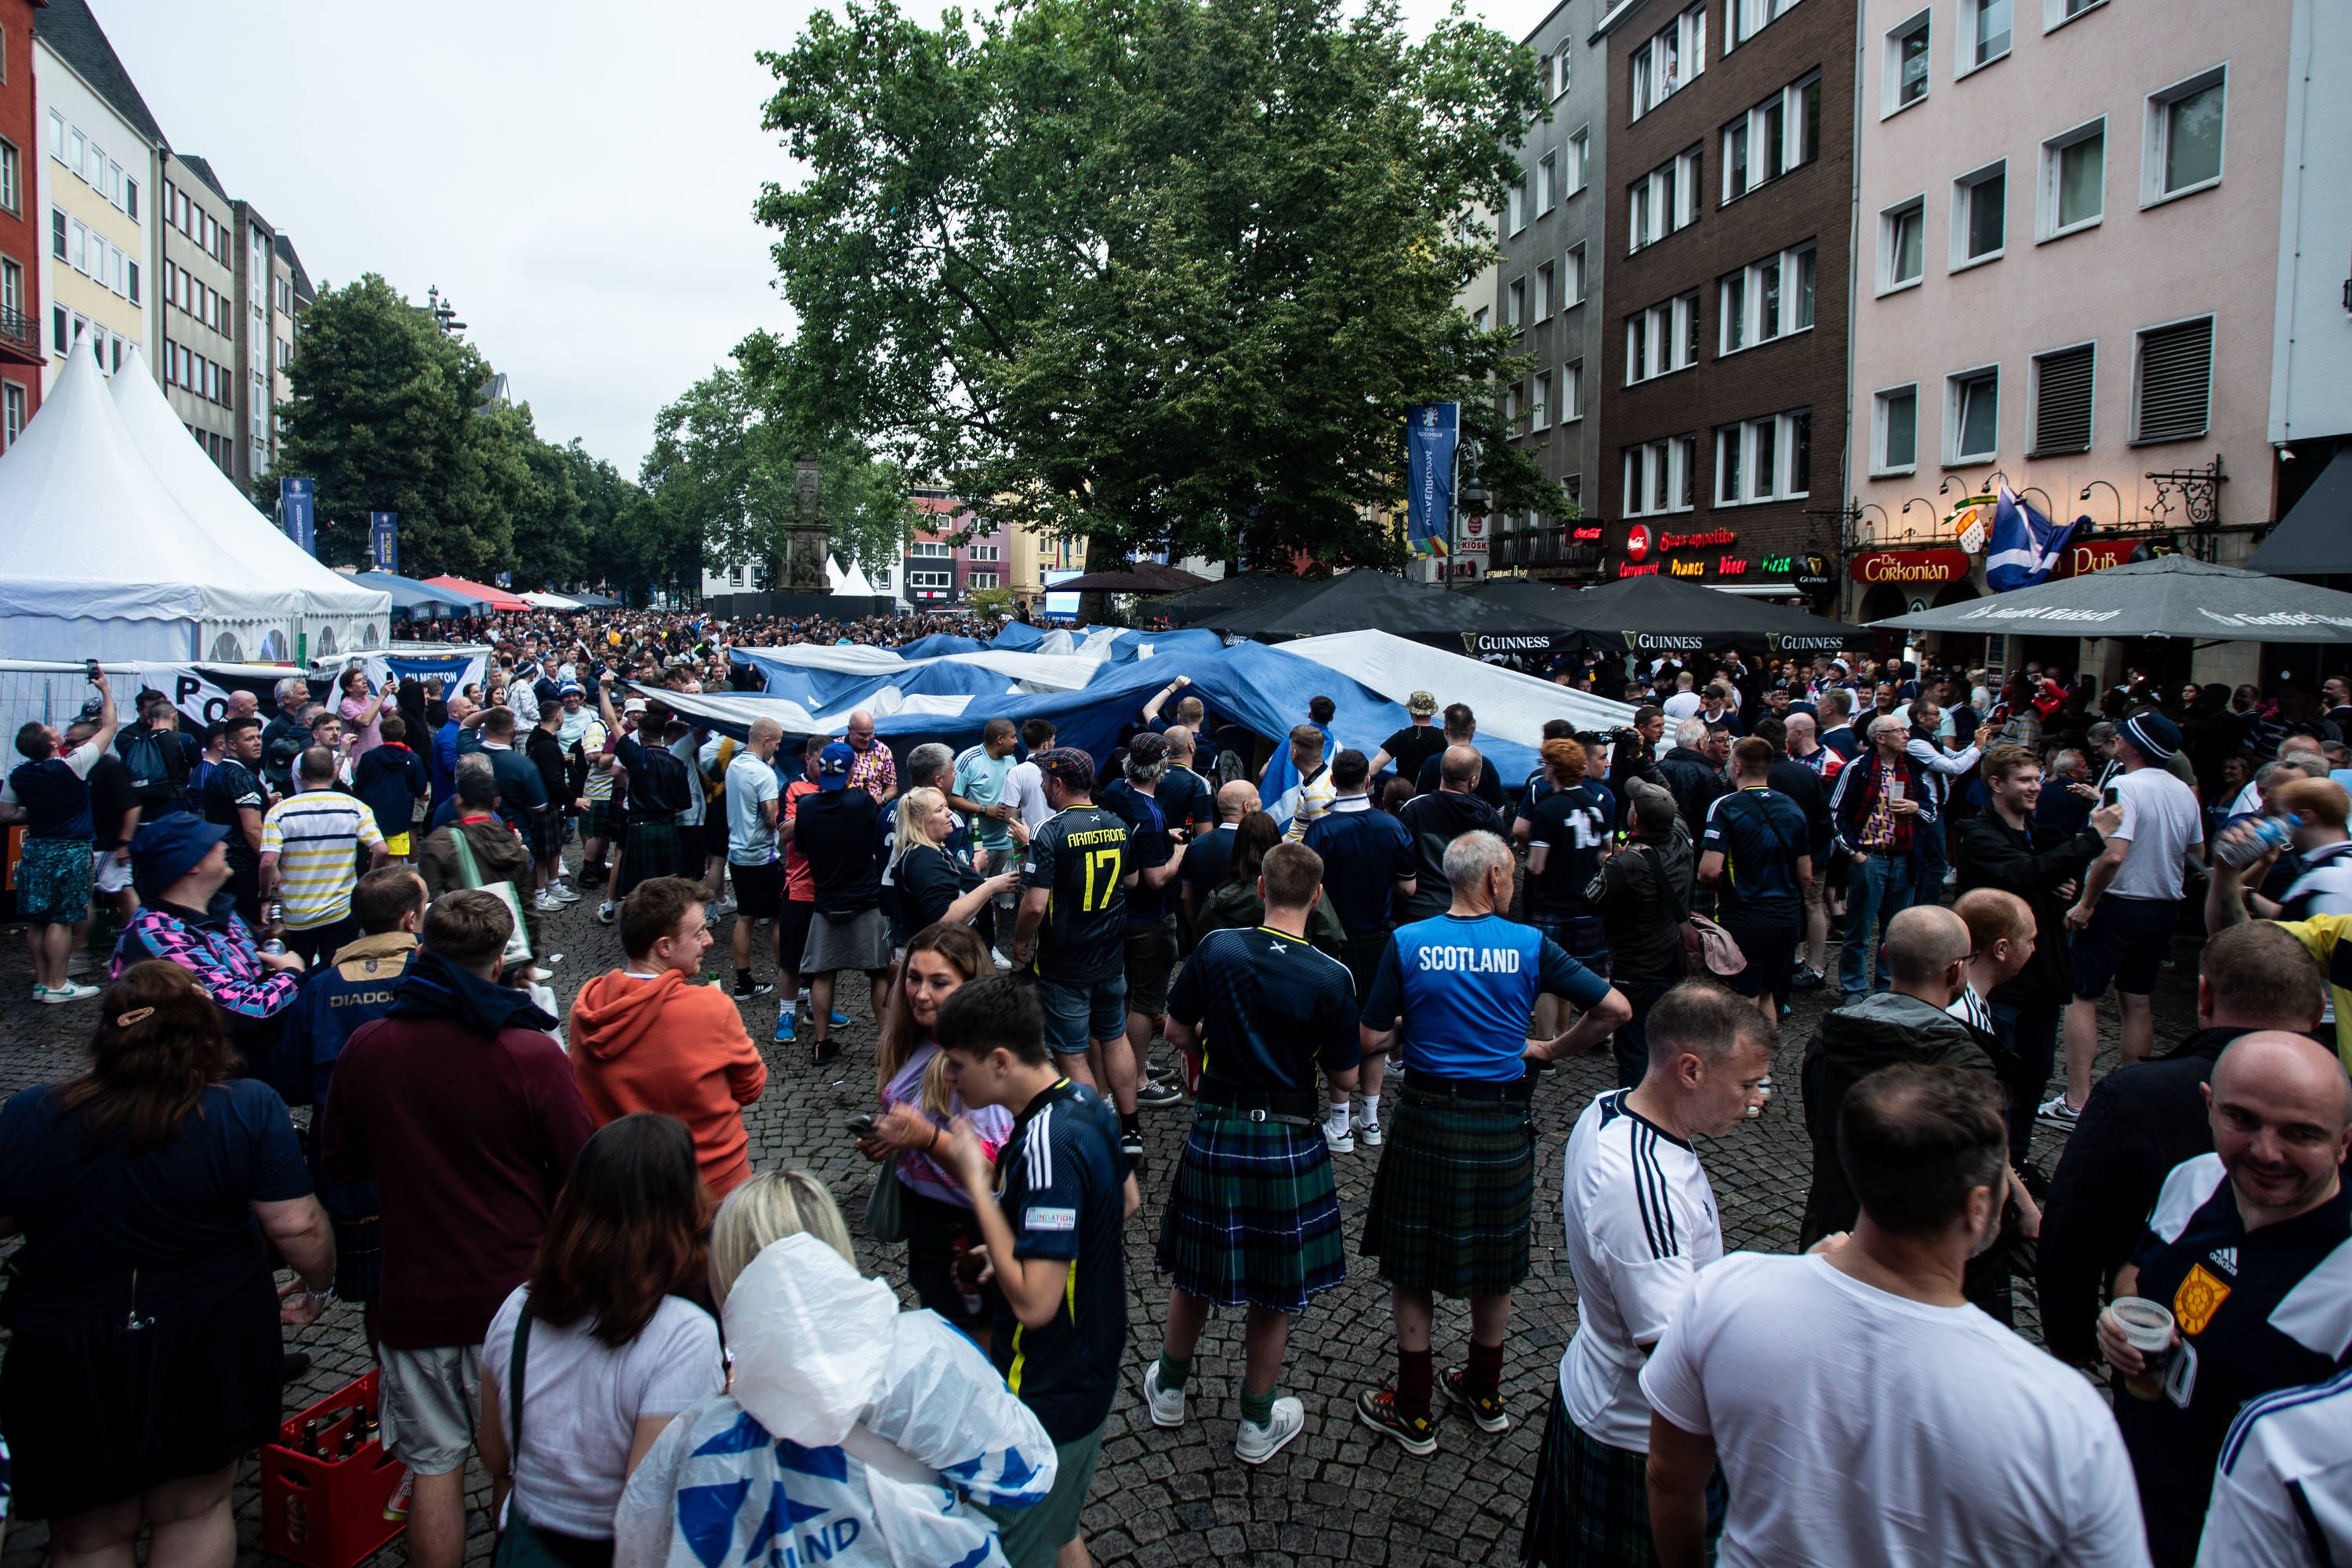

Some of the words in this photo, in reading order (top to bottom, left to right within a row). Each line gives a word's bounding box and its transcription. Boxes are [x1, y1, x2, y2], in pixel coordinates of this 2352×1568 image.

[1660, 532, 1686, 552] Buon
[1688, 528, 1735, 548] appetito
[1671, 559, 1704, 575] Pommes
[1719, 555, 1748, 575] Döner
[1762, 554, 1791, 573] Pizza
[1881, 554, 1896, 564] The
[1619, 561, 1661, 577] Currywurst
[1865, 558, 1949, 581] Corkonian
[1479, 635, 1550, 650] GUINNESS
[1639, 633, 1702, 649] GUINNESS
[1781, 635, 1842, 649] GUINNESS
[1067, 828, 1127, 848] ARMSTRONG
[1083, 848, 1121, 912] 17
[1419, 946, 1519, 973] SCOTLAND
[2209, 1252, 2238, 1276] adidas
